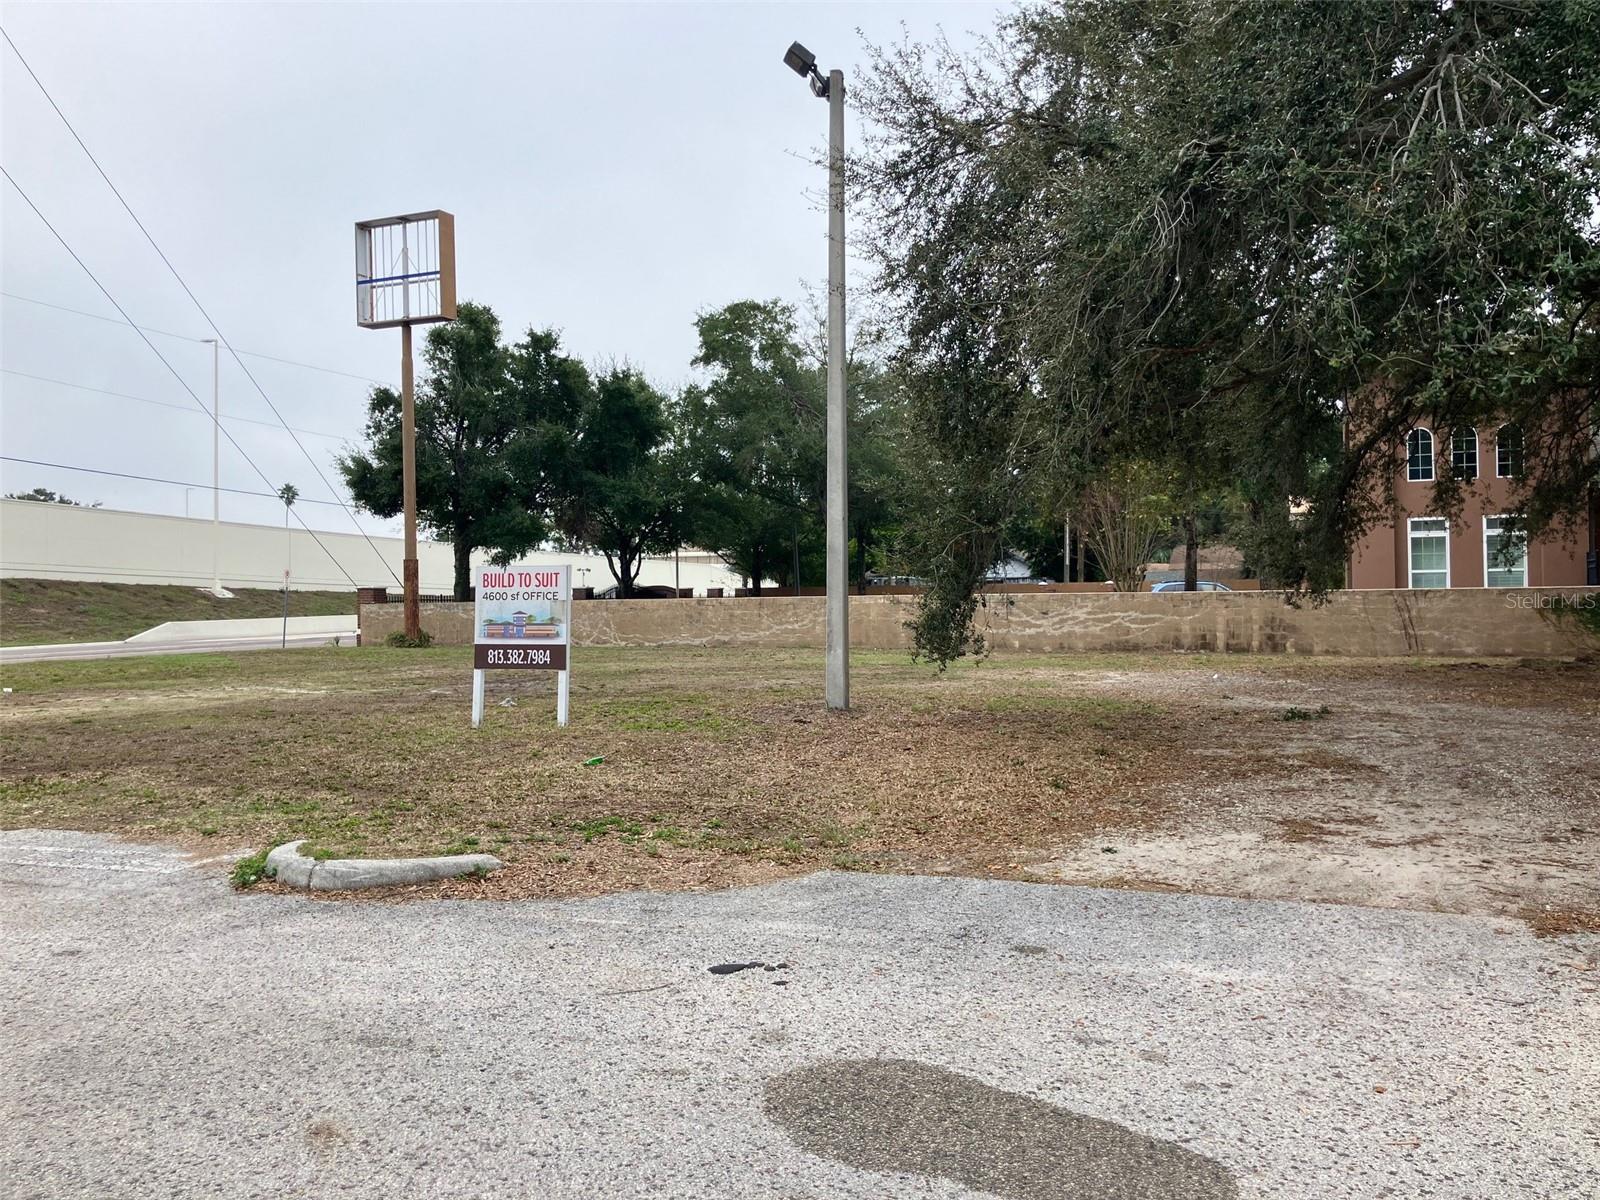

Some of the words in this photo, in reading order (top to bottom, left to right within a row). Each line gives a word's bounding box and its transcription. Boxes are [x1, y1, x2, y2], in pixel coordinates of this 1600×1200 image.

[483, 573, 515, 588] BUILD
[518, 573, 531, 588] TO
[535, 573, 560, 588] SUIT
[482, 592, 508, 601] 4600
[510, 591, 520, 601] sf
[522, 591, 559, 601] OFFICE
[487, 650, 551, 664] 813.382.7984
